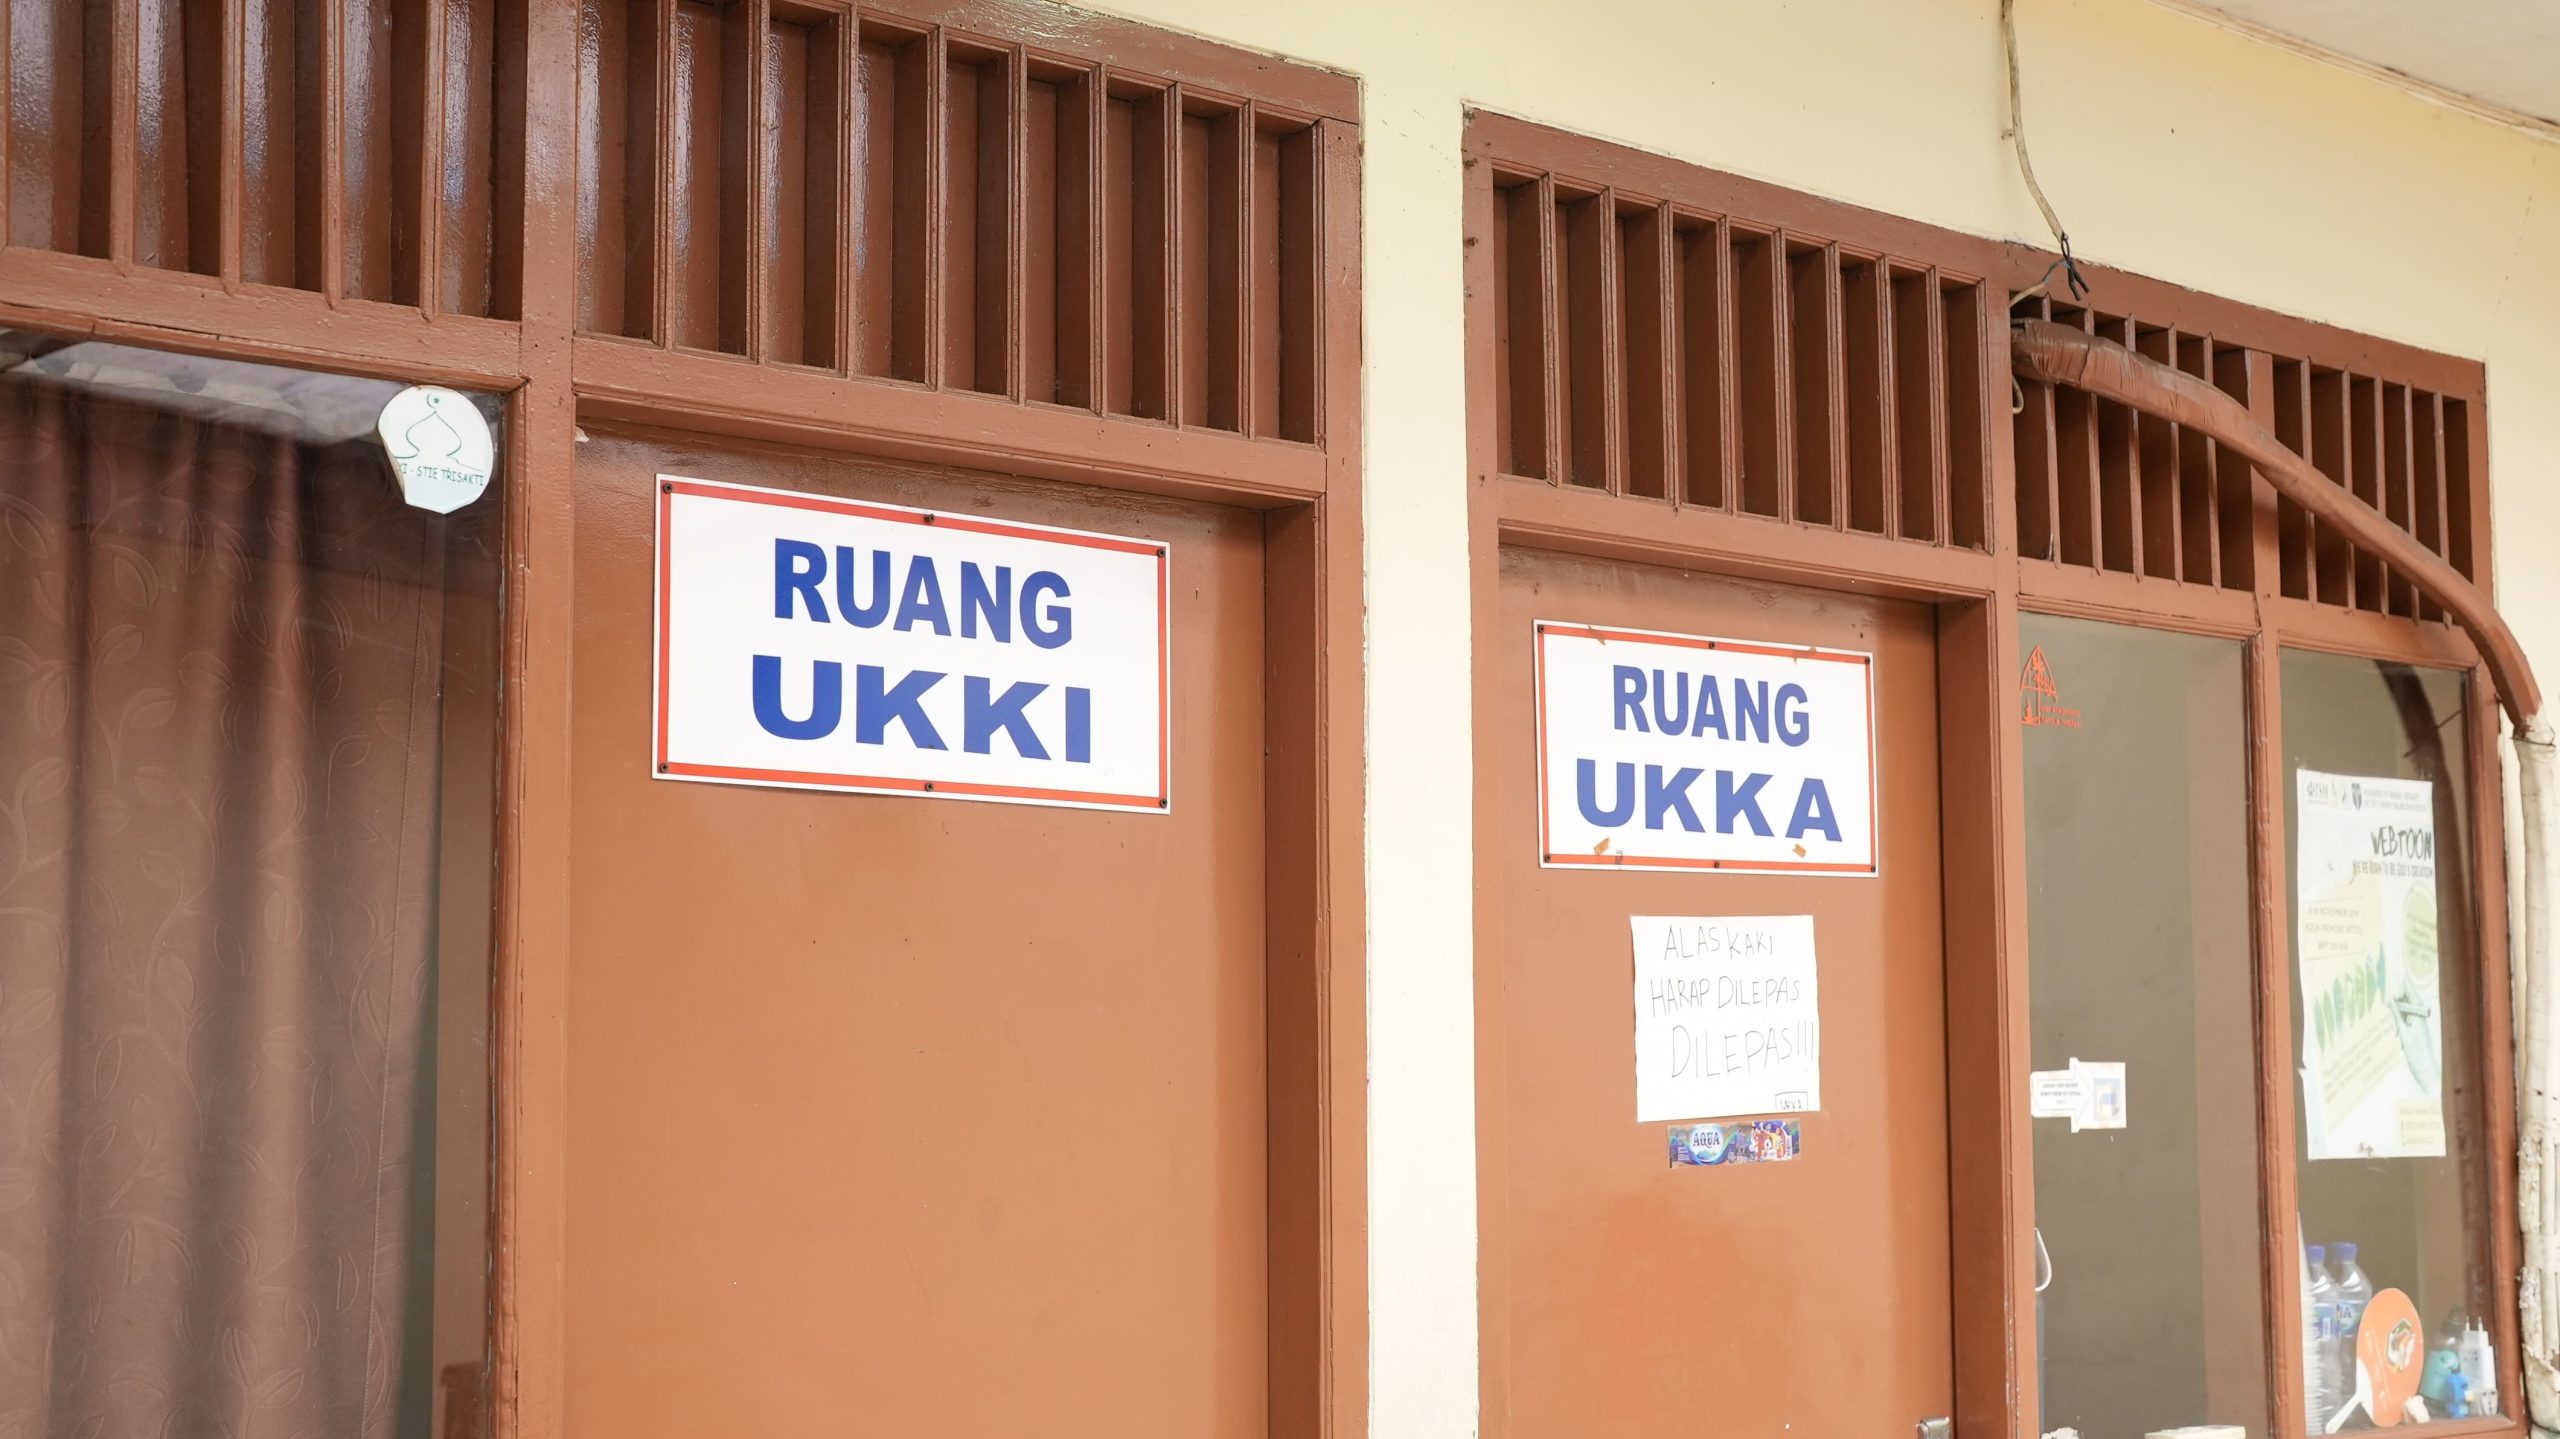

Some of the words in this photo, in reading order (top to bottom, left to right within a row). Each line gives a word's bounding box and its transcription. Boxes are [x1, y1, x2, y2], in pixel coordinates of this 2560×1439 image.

[416, 465, 438, 480] STIE
[441, 467, 486, 486] TRISAKTI
[774, 538, 1073, 650] RUANG
[752, 654, 1091, 764] UKKI
[1613, 664, 1810, 747] RUANG
[1576, 757, 1843, 843] UKKA
[1664, 924, 1721, 961] ALAS
[1725, 926, 1774, 960] KAKI
[1650, 976, 1711, 1018] HARAP
[1717, 975, 1801, 1009] DILEPAS
[1671, 1019, 1815, 1080] DILEPAS!!!
[1692, 1131, 1721, 1149] AQUA
